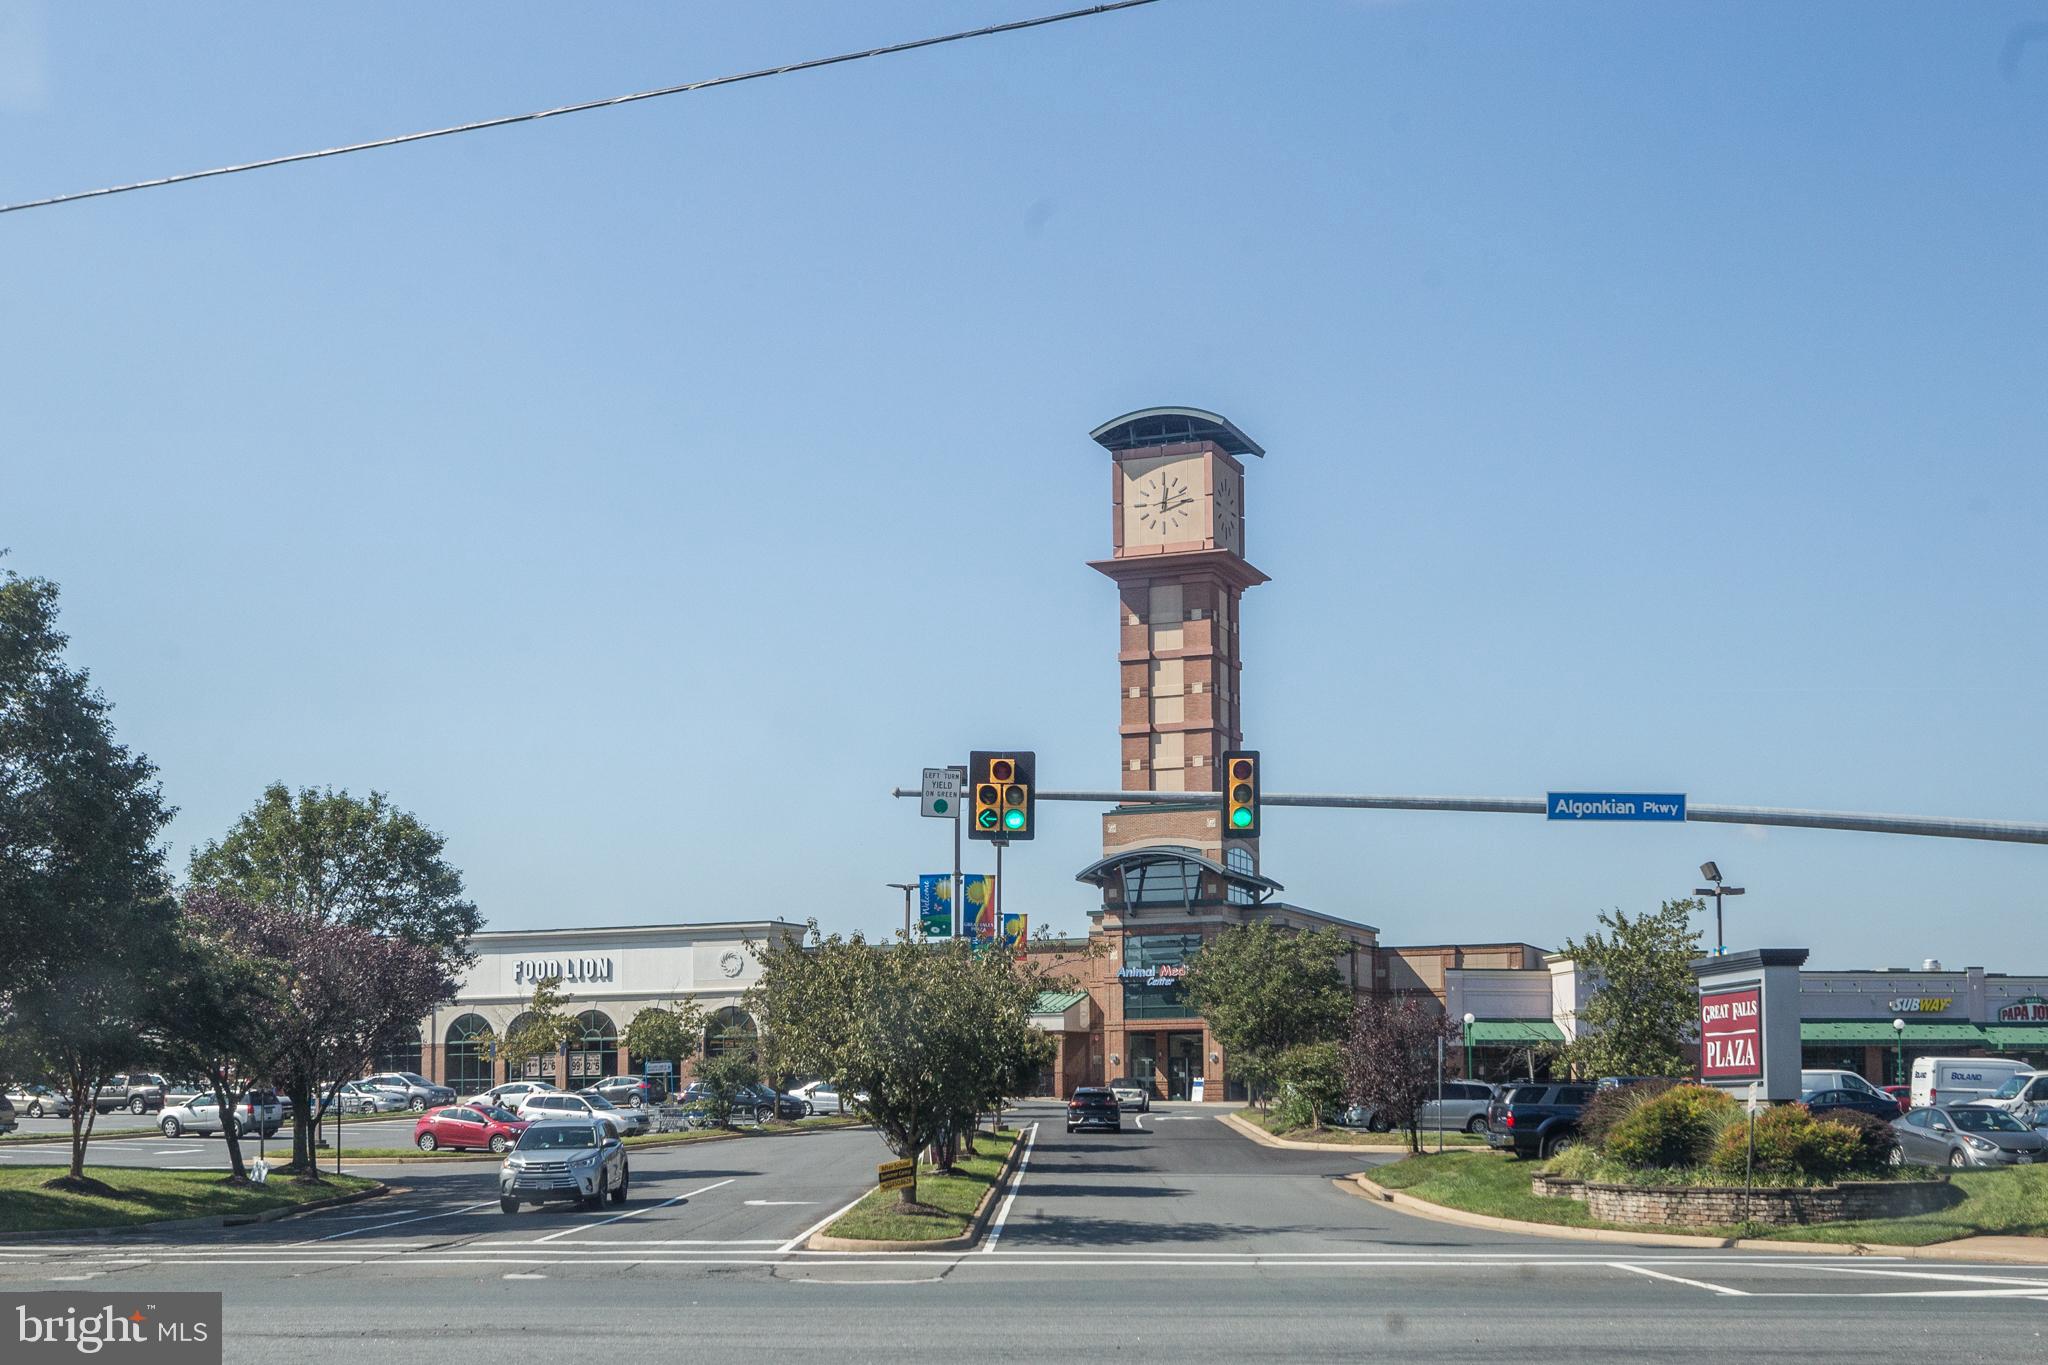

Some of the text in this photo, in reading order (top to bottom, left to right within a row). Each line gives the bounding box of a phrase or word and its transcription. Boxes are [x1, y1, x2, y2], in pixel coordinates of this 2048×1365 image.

[932, 781, 953, 790] YIELD
[1555, 799, 1679, 818] Algonkian Pkwy
[921, 880, 931, 915] Welcome
[513, 957, 612, 980] FOOD LION
[1117, 964, 1156, 977] Animal
[1147, 977, 1175, 986] Center
[1703, 1000, 1758, 1024] GREAT FALLS
[1891, 997, 1953, 1012] SUBWAY
[2002, 1005, 2030, 1021] PAPA
[1706, 1039, 1756, 1068] PLAZA
[1951, 1072, 1983, 1081] BOLAND
